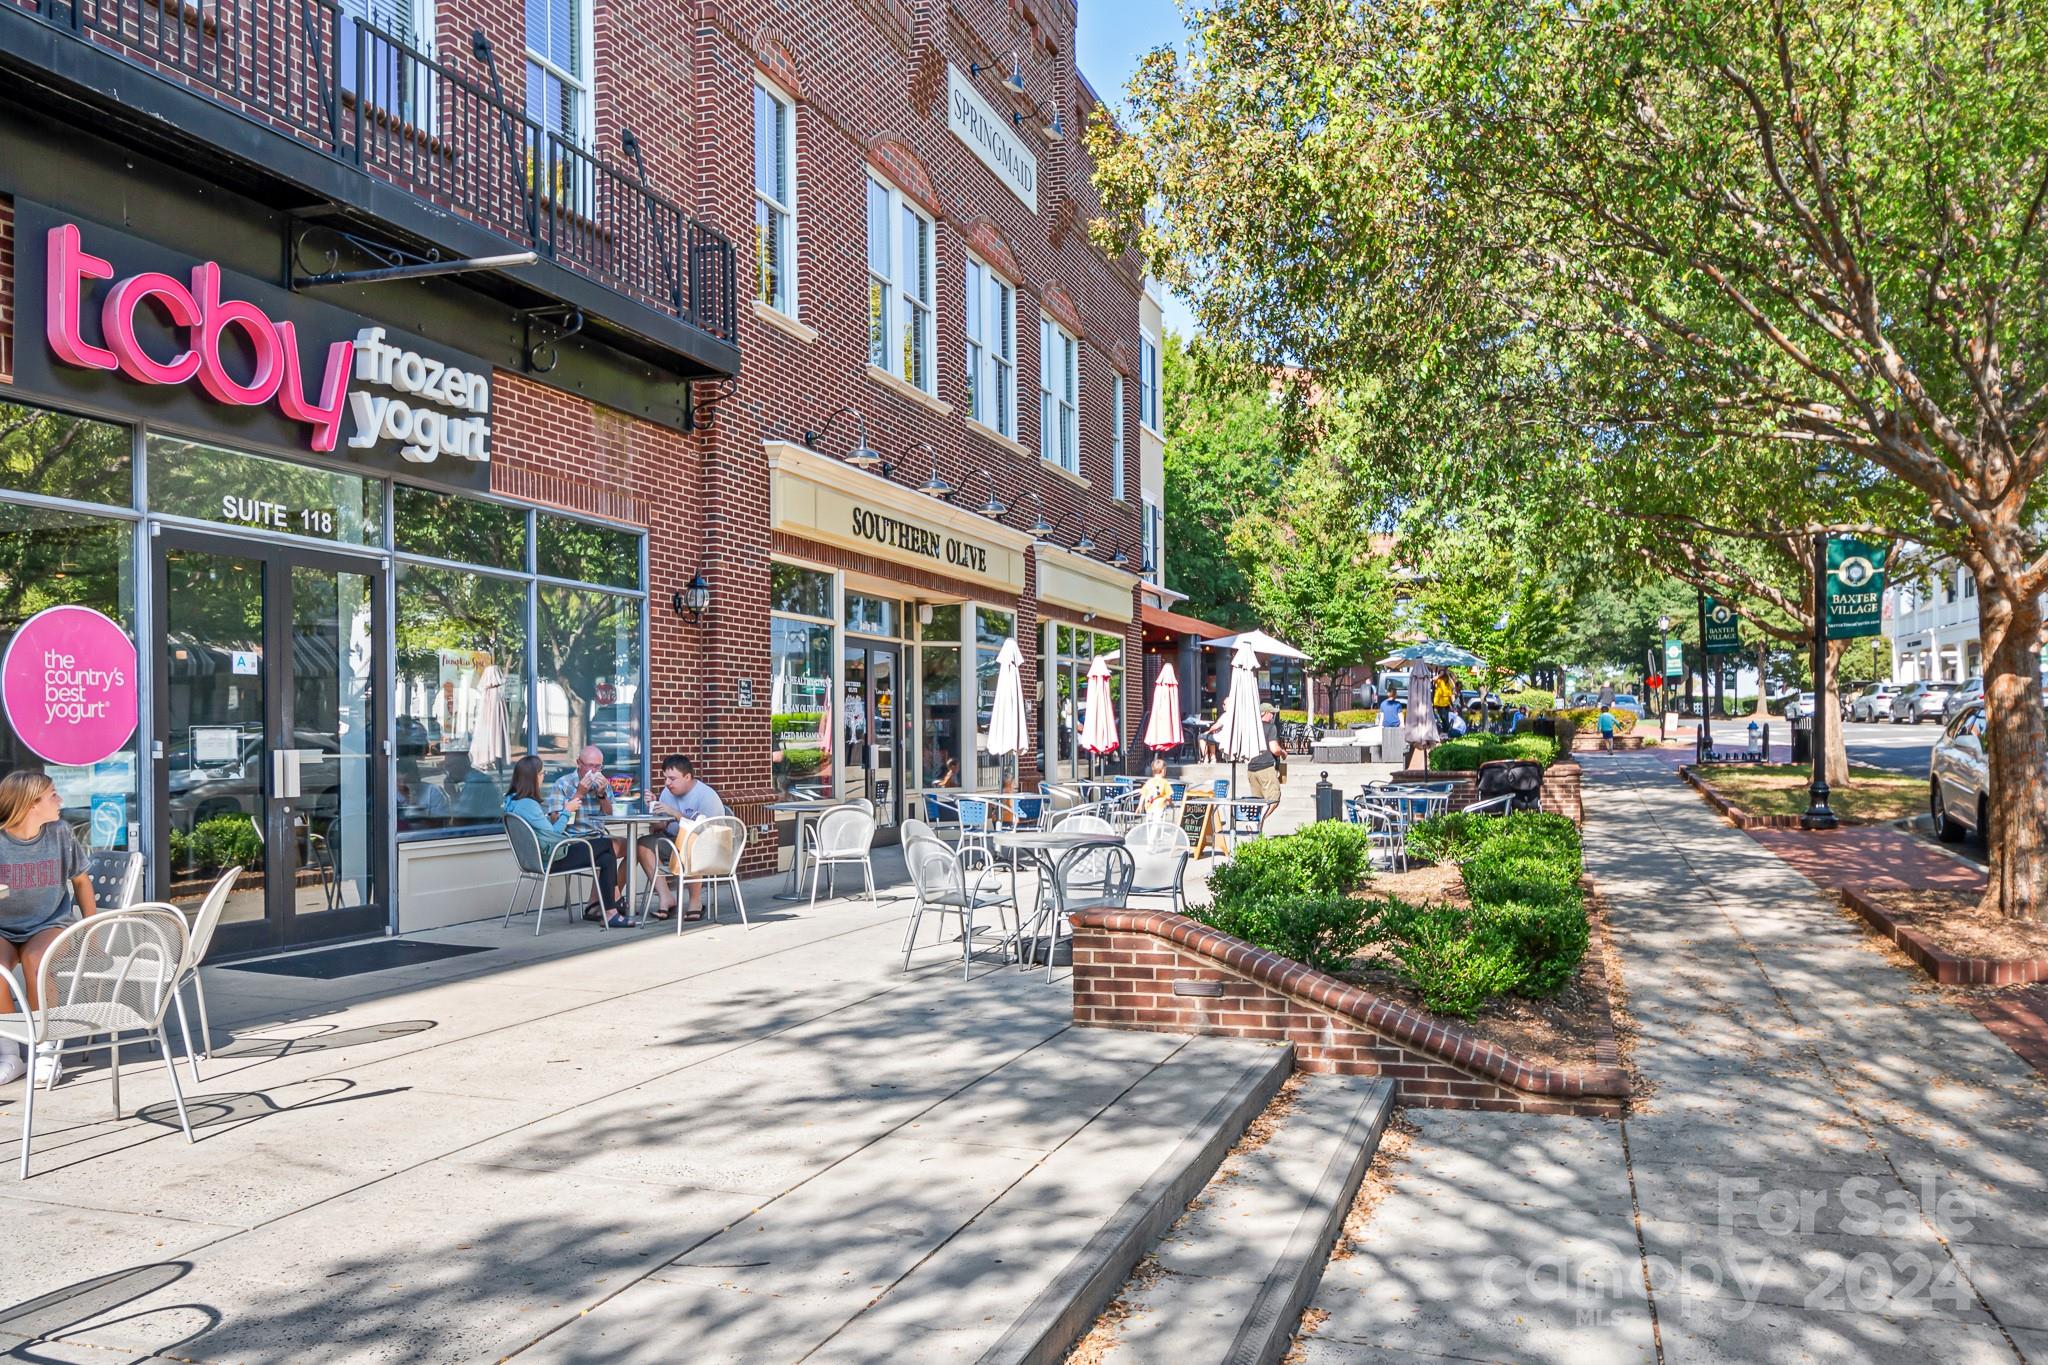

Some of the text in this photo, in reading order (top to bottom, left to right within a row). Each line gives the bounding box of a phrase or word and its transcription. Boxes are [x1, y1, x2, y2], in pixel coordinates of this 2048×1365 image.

[953, 88, 1033, 193] SPRINGMAID
[46, 223, 354, 453] tcby
[353, 326, 490, 414] frozen
[348, 390, 491, 464] yogurt
[222, 494, 333, 534] SUITE 118
[852, 506, 987, 573] SOUTHERN OLIVE
[1830, 603, 1879, 616] VILLAGE
[1832, 592, 1878, 604] BAXTER
[1708, 633, 1737, 641] VILLAGE
[1709, 626, 1735, 634] BAXTER
[44, 648, 76, 669] the
[237, 655, 246, 667] A
[44, 667, 125, 692] country's
[45, 683, 86, 702] best
[44, 700, 106, 725] yogurt
